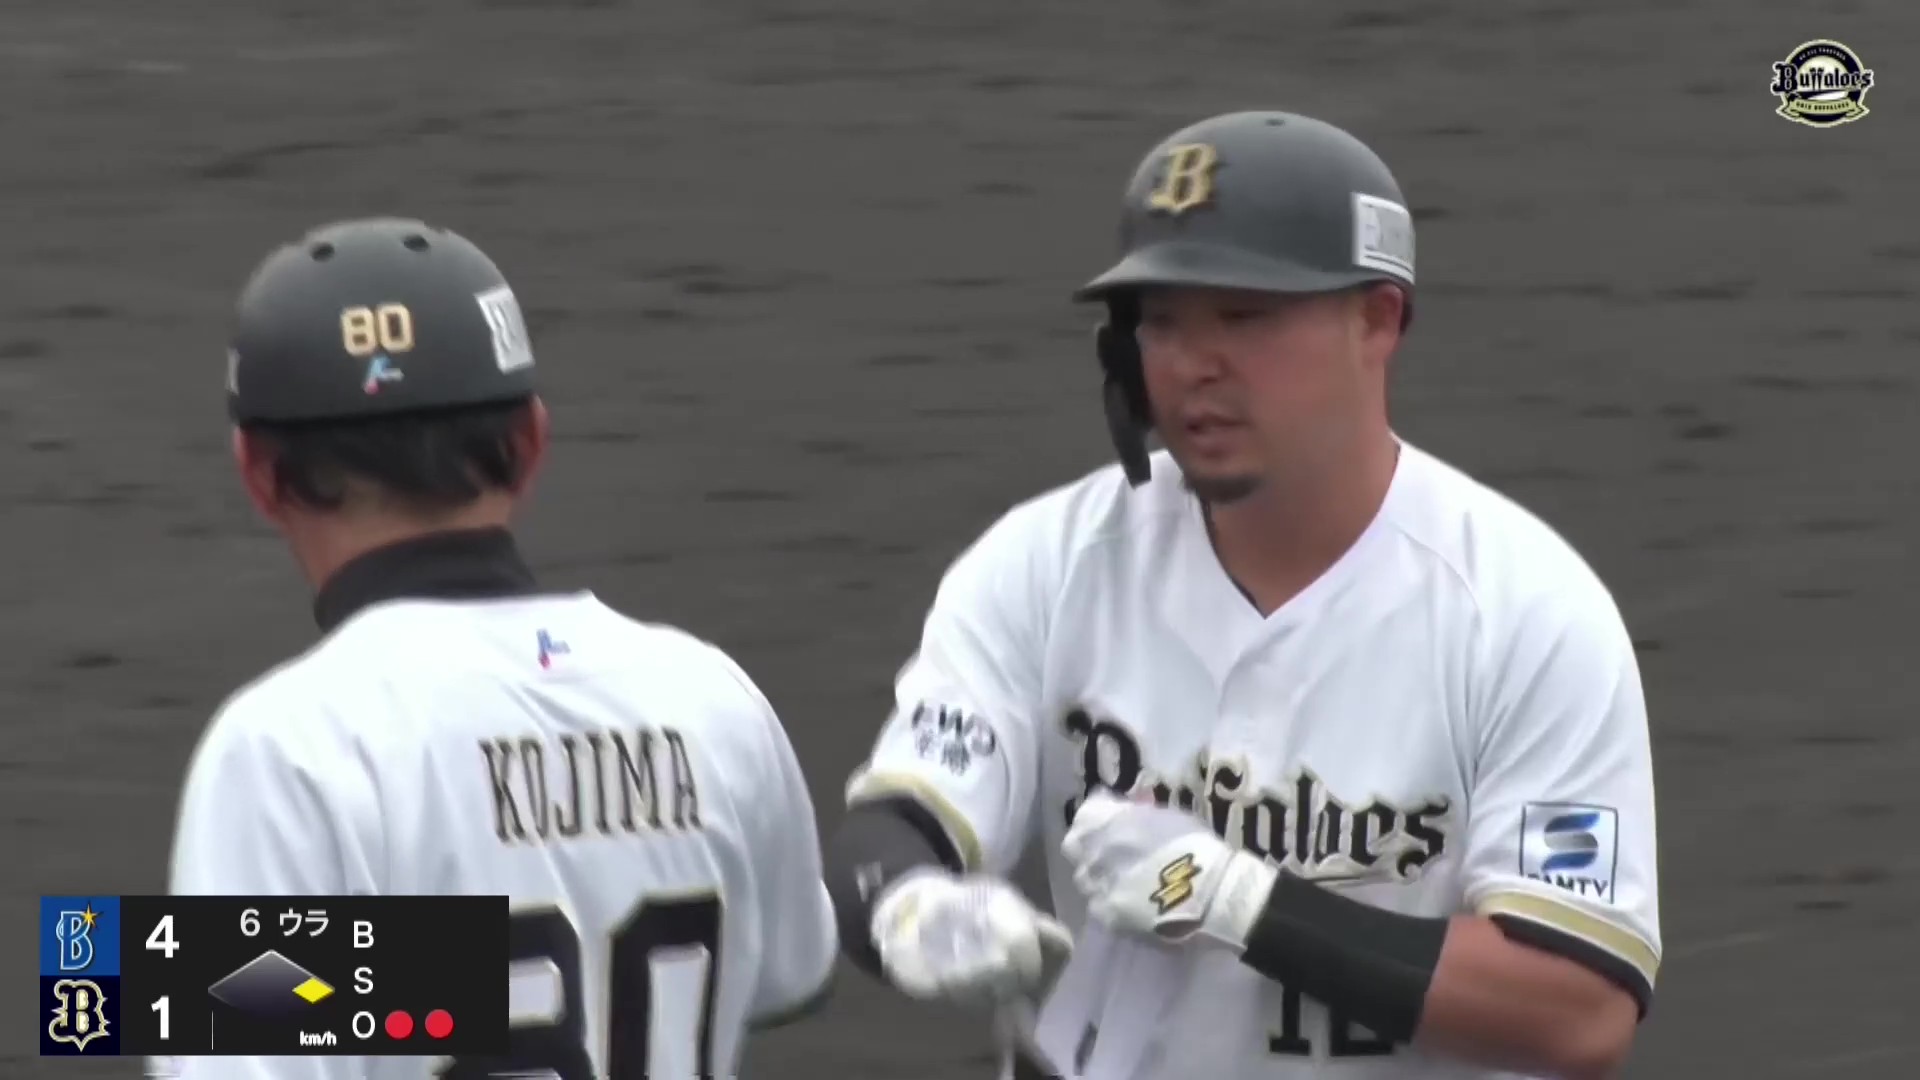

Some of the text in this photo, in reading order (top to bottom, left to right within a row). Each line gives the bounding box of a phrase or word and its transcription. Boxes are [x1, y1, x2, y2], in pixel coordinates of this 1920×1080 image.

[1147, 142, 1217, 216] B
[340, 303, 416, 357] 80
[478, 727, 703, 846] KOJIMA
